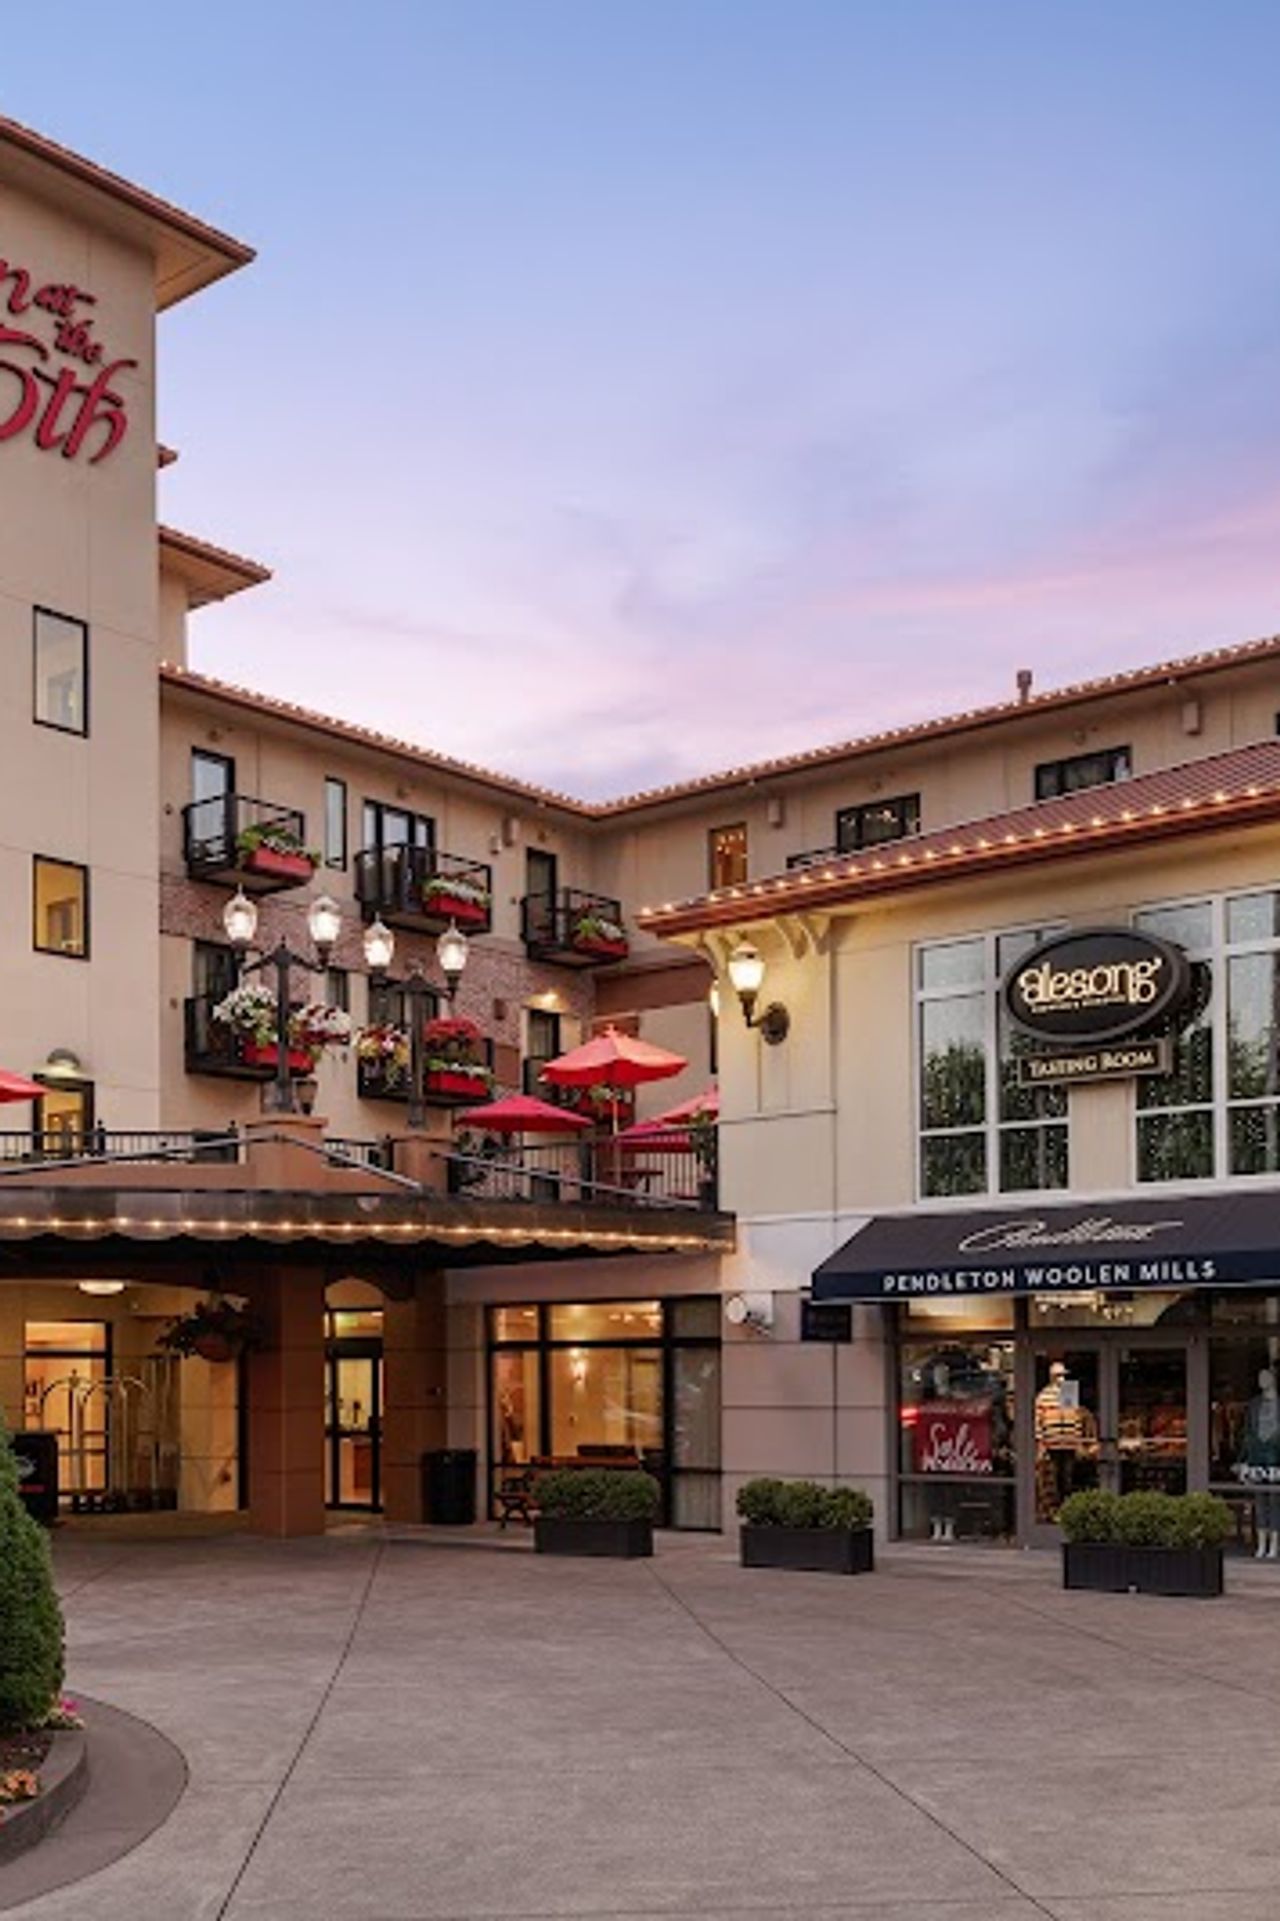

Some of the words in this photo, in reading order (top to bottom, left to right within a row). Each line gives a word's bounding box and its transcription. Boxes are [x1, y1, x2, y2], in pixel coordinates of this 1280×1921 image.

[1018, 957, 1163, 1004] alesong
[1099, 1050, 1155, 1072] ROOM
[883, 1269, 1015, 1291] PENDLETON
[1024, 1263, 1130, 1286] WOOLEN
[1139, 1260, 1217, 1281] MILLS
